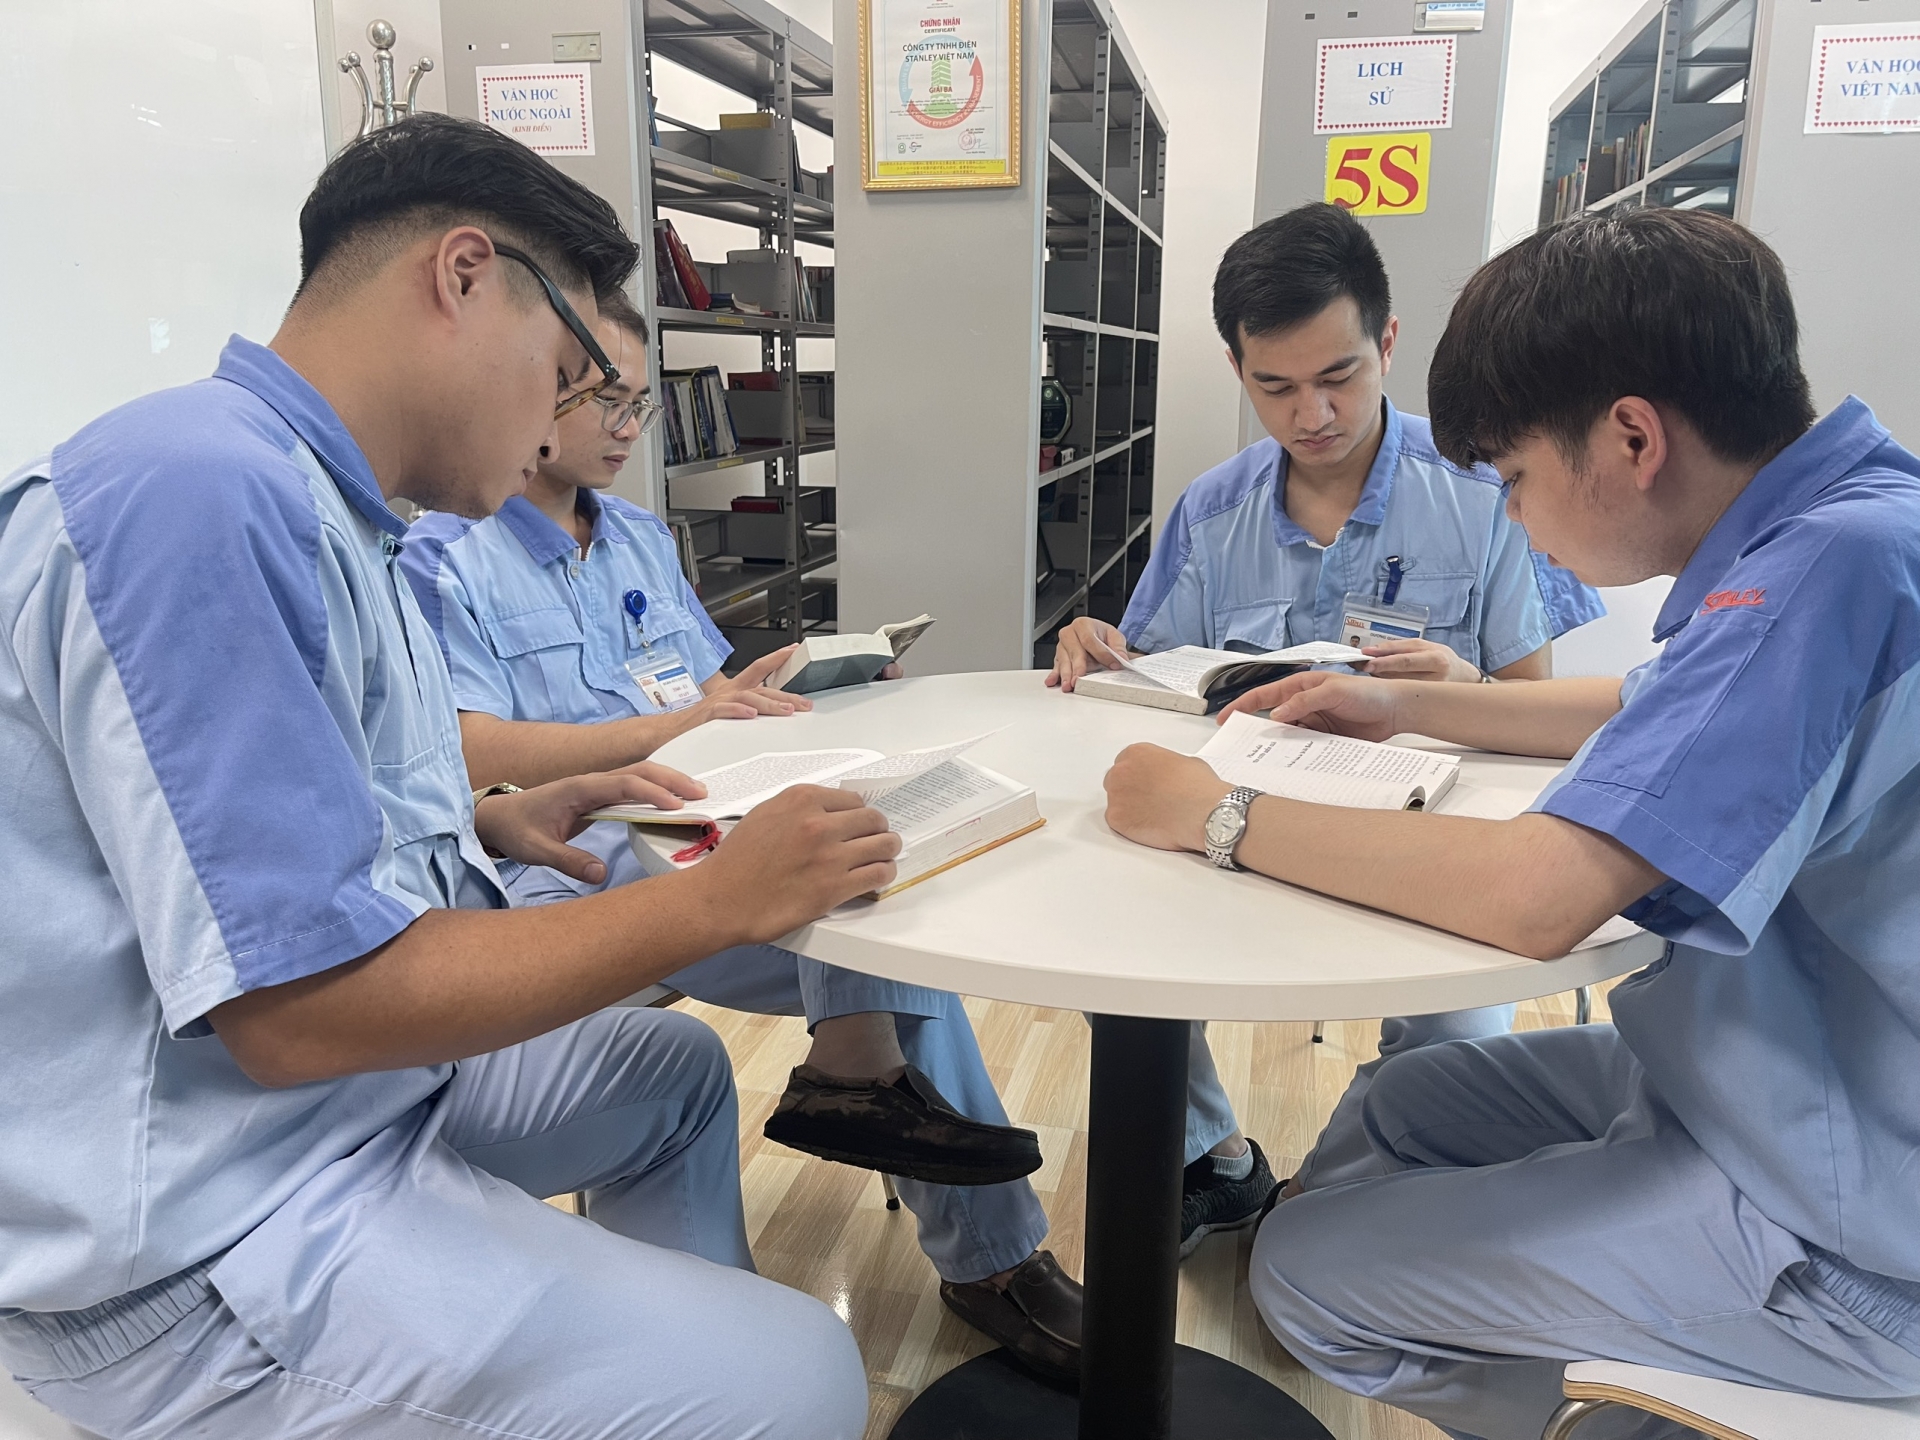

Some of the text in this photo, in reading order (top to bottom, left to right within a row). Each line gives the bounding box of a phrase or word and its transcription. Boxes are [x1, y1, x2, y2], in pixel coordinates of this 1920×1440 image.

[902, 43, 924, 52] CÔNG
[925, 43, 934, 51] TY
[936, 42, 957, 50] TNHH
[905, 52, 974, 62] STANLEY VIỆT NAM
[1357, 61, 1404, 81] LỊCH
[1846, 59, 1884, 74] VĂN
[501, 88, 559, 103] VĂN HỌC
[1368, 86, 1395, 106] SỬ
[1840, 80, 1883, 100] VIỆT
[491, 104, 571, 122] NƯỚC NGOÀI
[512, 122, 552, 134] (KINH ĐIỂN)
[1333, 144, 1419, 210] 5S
